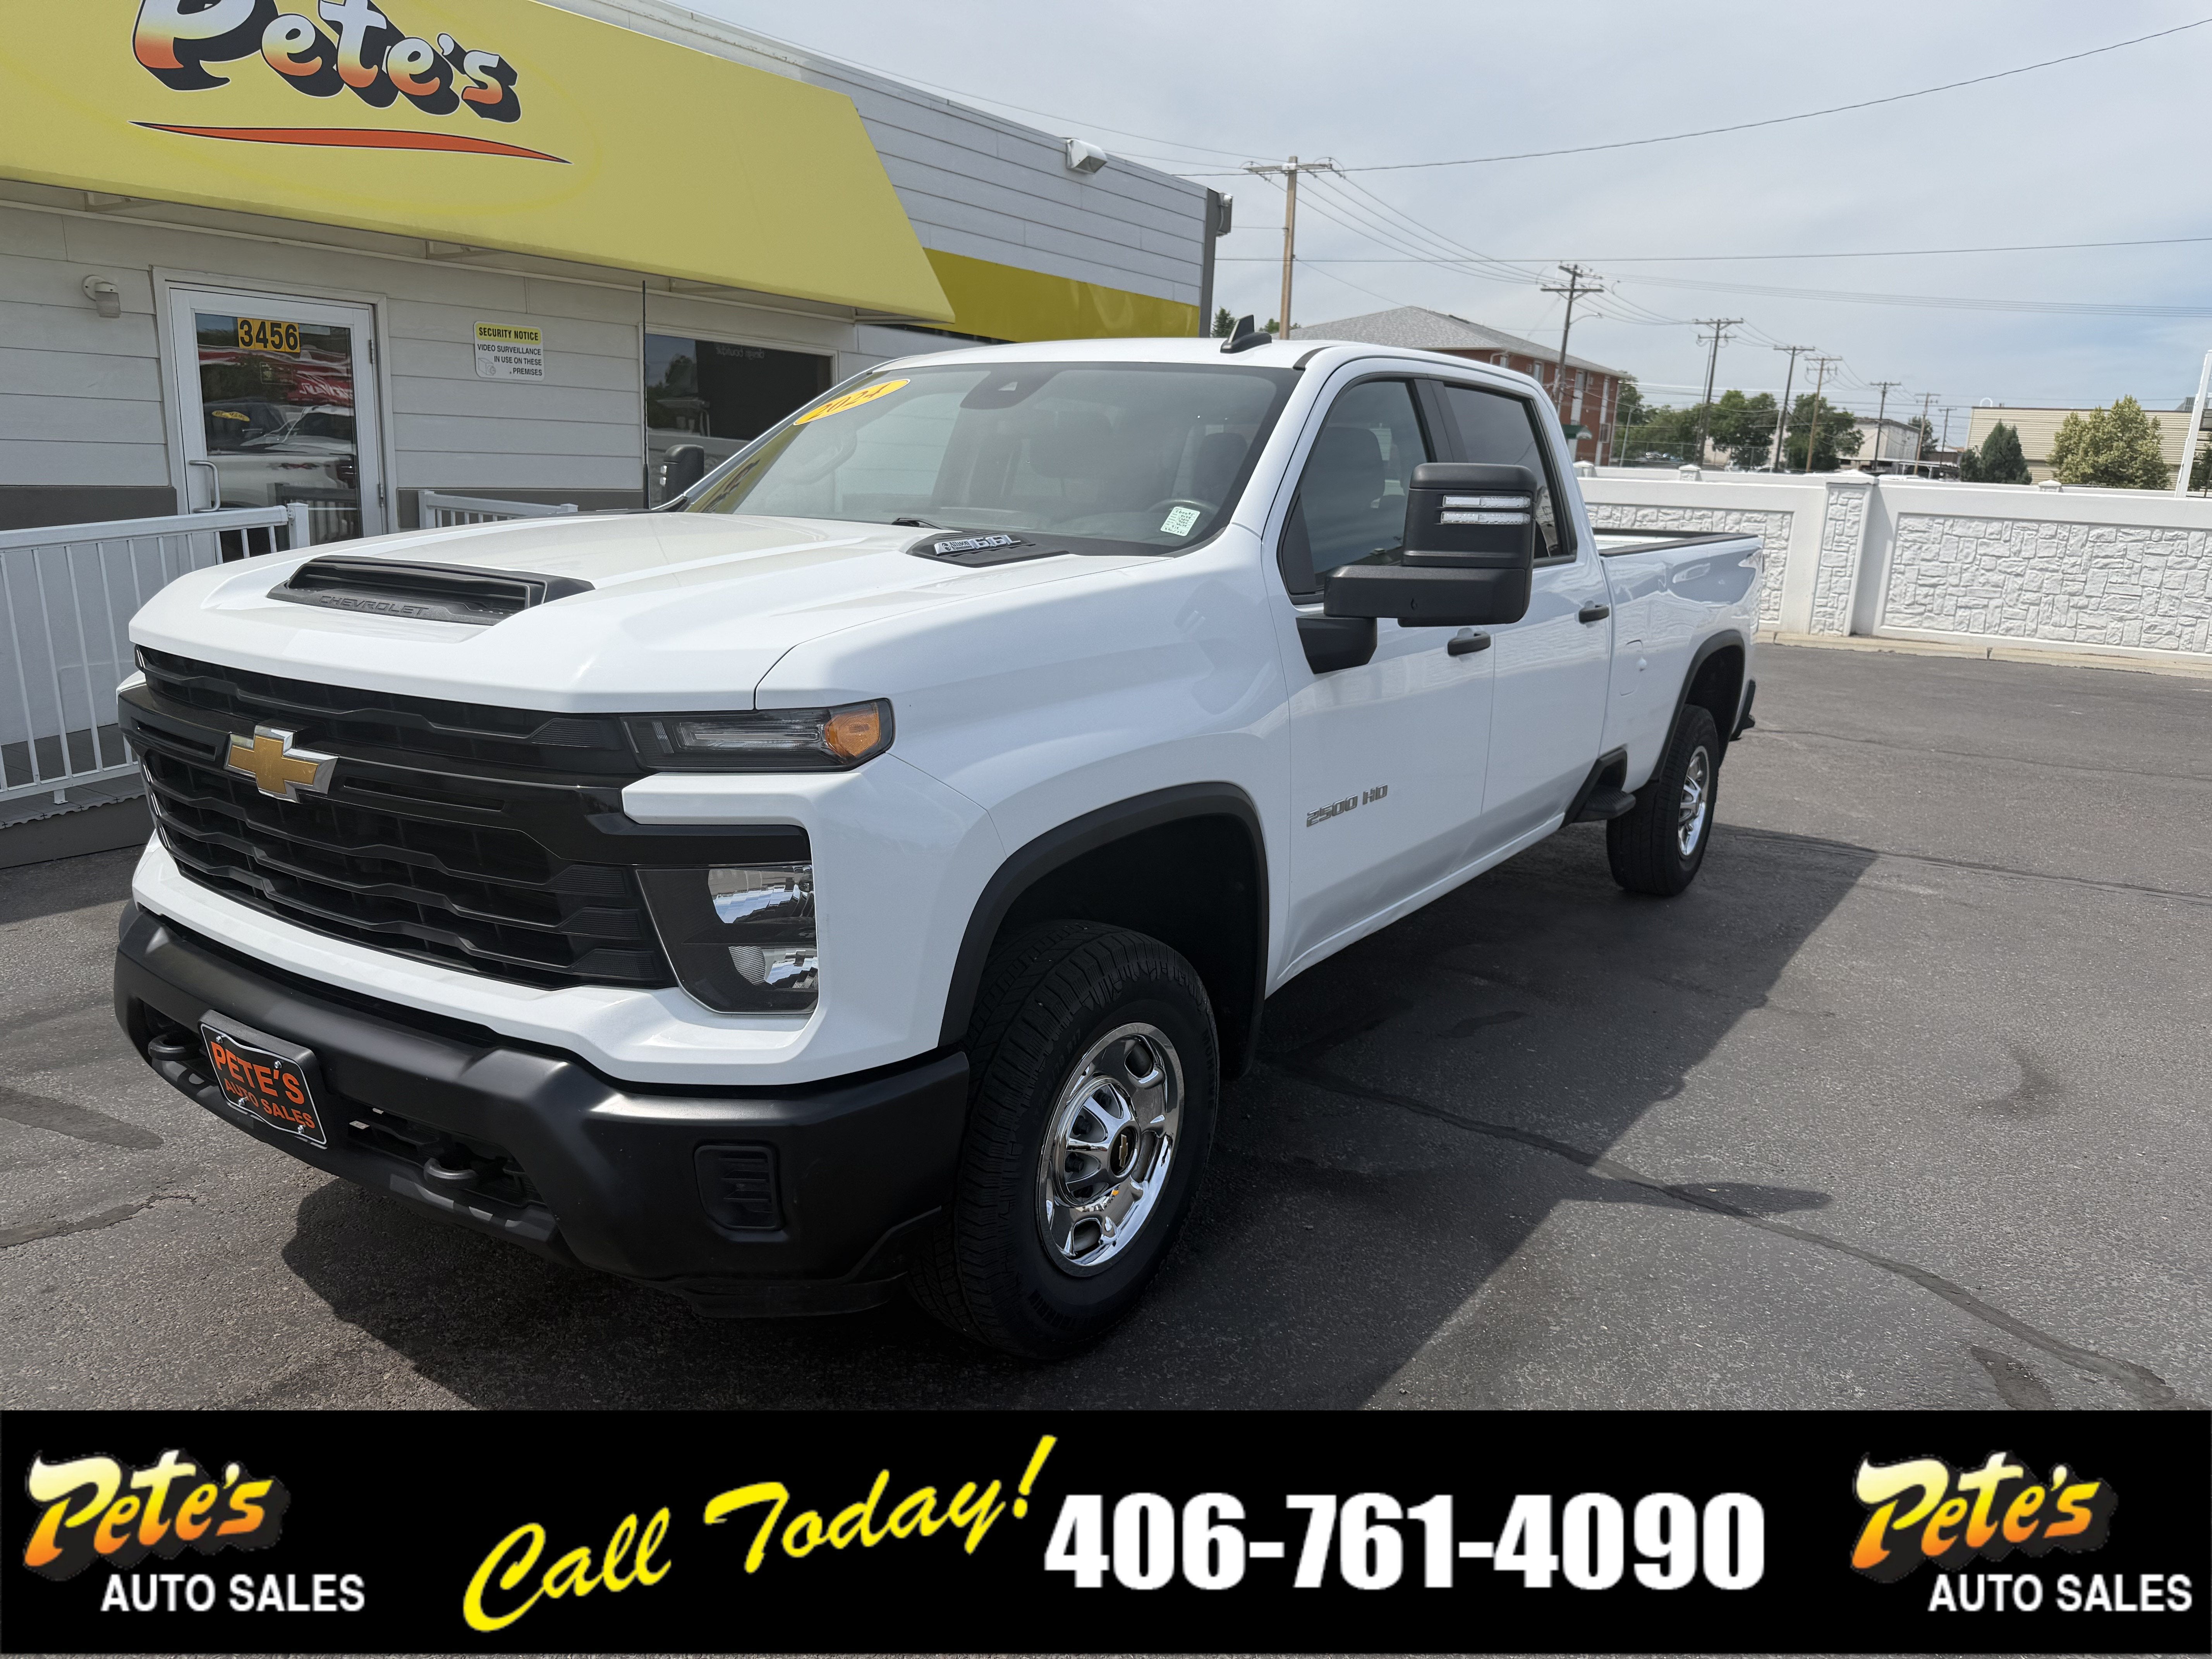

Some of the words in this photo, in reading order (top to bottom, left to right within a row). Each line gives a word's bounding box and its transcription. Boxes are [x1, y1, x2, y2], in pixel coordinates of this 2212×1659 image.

[133, 0, 521, 123] Pete's
[239, 319, 299, 350] 3456
[477, 343, 496, 352] VIDEO
[497, 345, 541, 356] SURVEILLANCE
[479, 327, 512, 338] SECURITY
[514, 330, 539, 341] NOTICE
[513, 367, 543, 376] PREMISES
[524, 358, 542, 366] THESE
[807, 382, 891, 421] 2024
[319, 595, 429, 617] CHEVROLET
[1306, 794, 1358, 828] 2500
[1362, 784, 1388, 805] HD
[210, 1041, 305, 1104] PETE'S
[224, 1078, 259, 1108] AUTO
[260, 1098, 316, 1129] SALES
